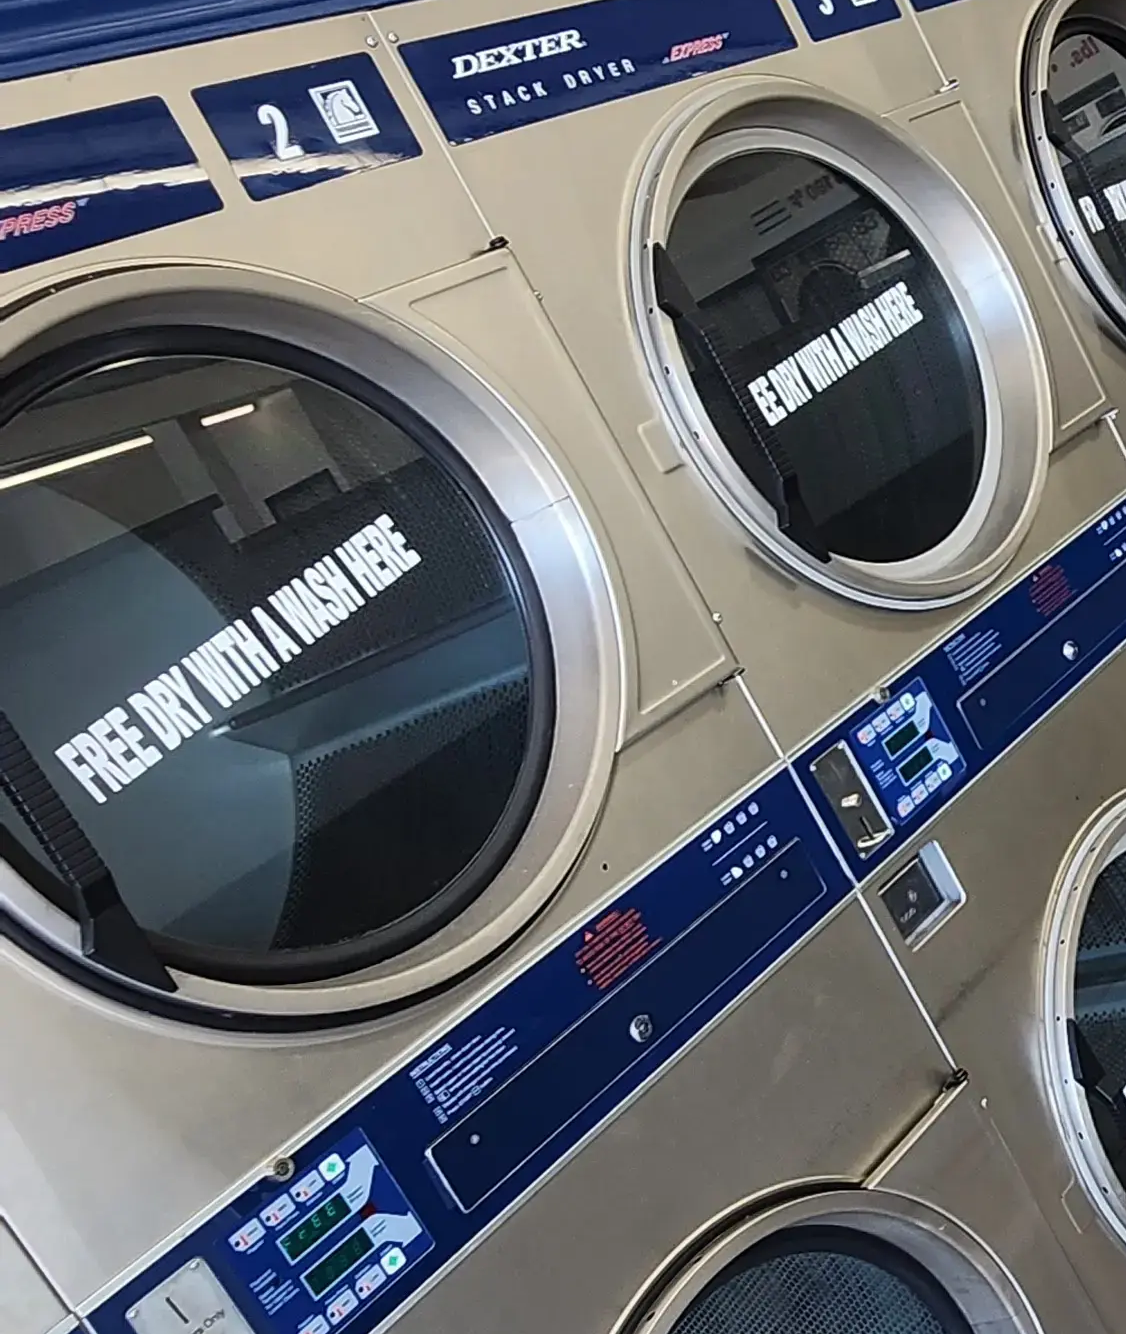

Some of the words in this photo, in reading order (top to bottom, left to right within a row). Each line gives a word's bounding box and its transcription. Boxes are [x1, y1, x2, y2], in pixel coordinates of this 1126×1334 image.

[452, 28, 586, 80] DEXTER
[667, 33, 725, 63] EXPRESS
[466, 82, 548, 117] STACK
[566, 58, 636, 91] DRYER
[256, 103, 305, 161] 2
[0, 201, 77, 241] PRESS
[838, 301, 894, 362] WASH
[873, 281, 924, 338] HERE
[793, 333, 848, 393] WITH
[829, 326, 860, 371] A
[747, 375, 788, 427] EE
[766, 355, 813, 413] DRY
[334, 512, 423, 599] HERE
[267, 554, 367, 646] WASH
[180, 618, 281, 709] WITH
[250, 605, 303, 664] A
[126, 664, 213, 752] DRY
[53, 705, 164, 805] FREE
[203, 1308, 226, 1329] Only
